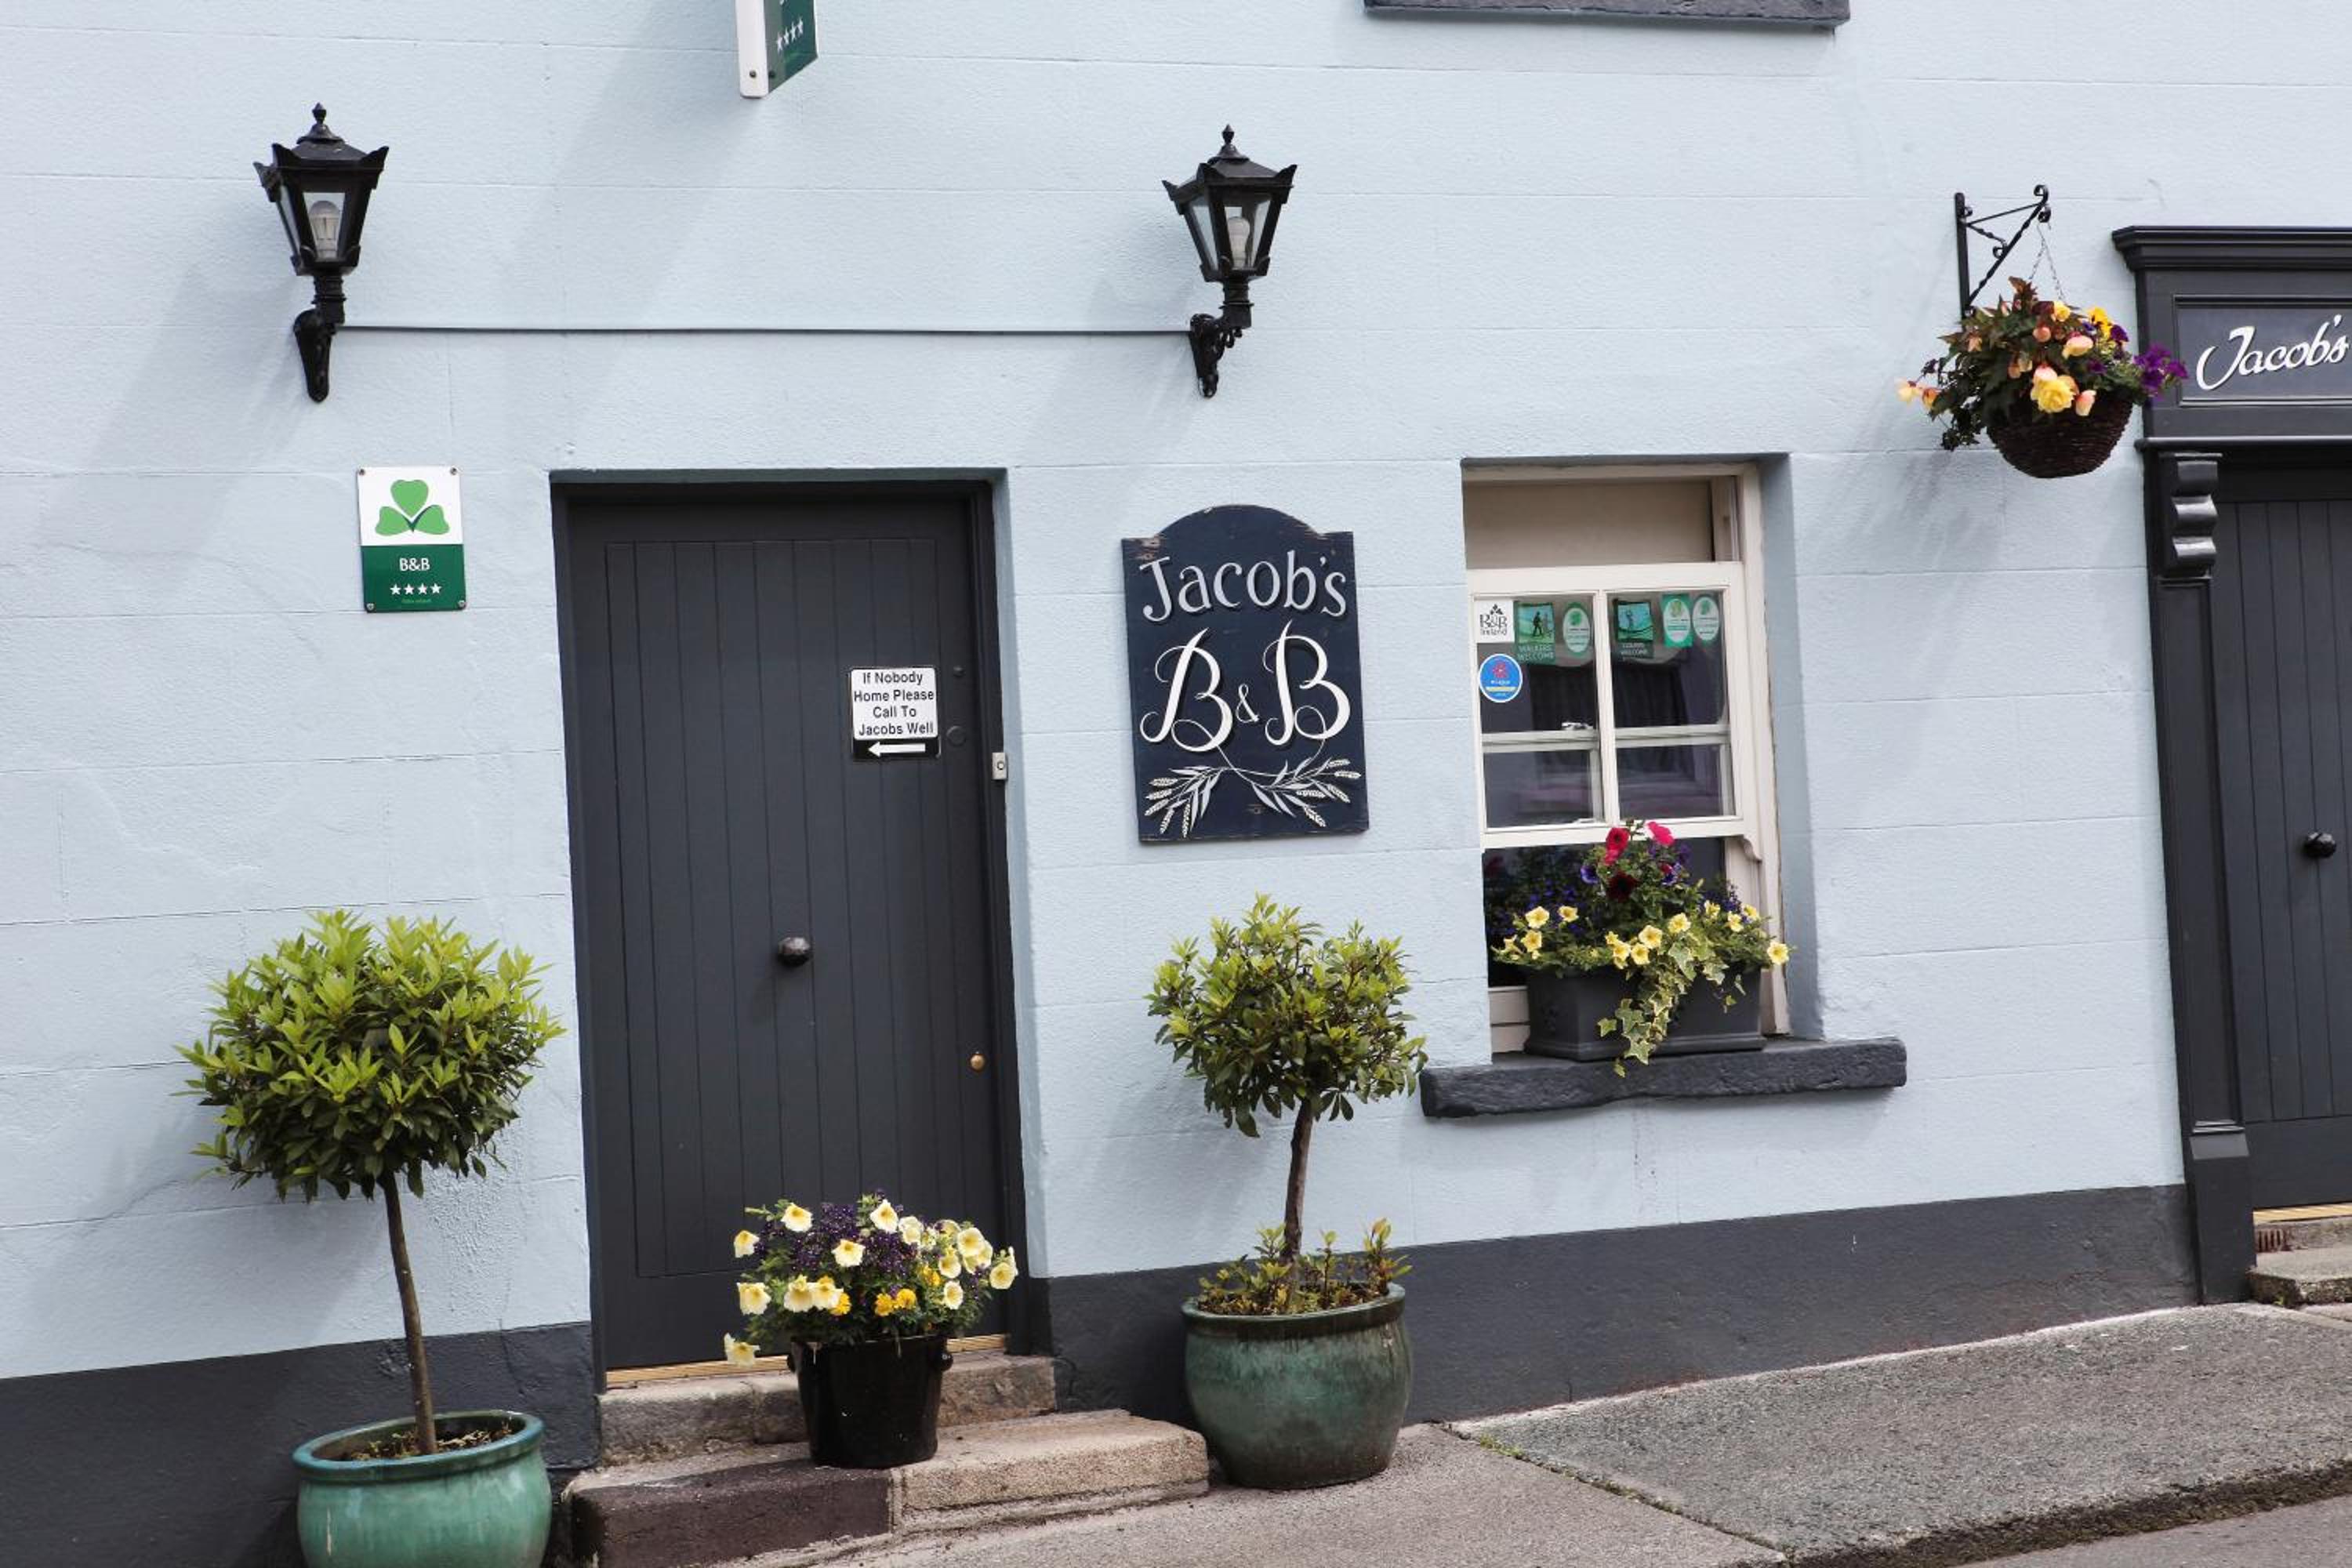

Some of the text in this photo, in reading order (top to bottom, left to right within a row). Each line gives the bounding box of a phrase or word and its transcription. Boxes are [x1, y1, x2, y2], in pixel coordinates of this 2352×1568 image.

[2196, 314, 2350, 390] Jacob's
[399, 557, 430, 572] B&B
[1139, 550, 1347, 622] Jacob's
[863, 671, 923, 685] If Nobody
[854, 689, 935, 702] Home Please
[873, 706, 916, 718] Call To
[859, 721, 934, 735] Jacobs Well
